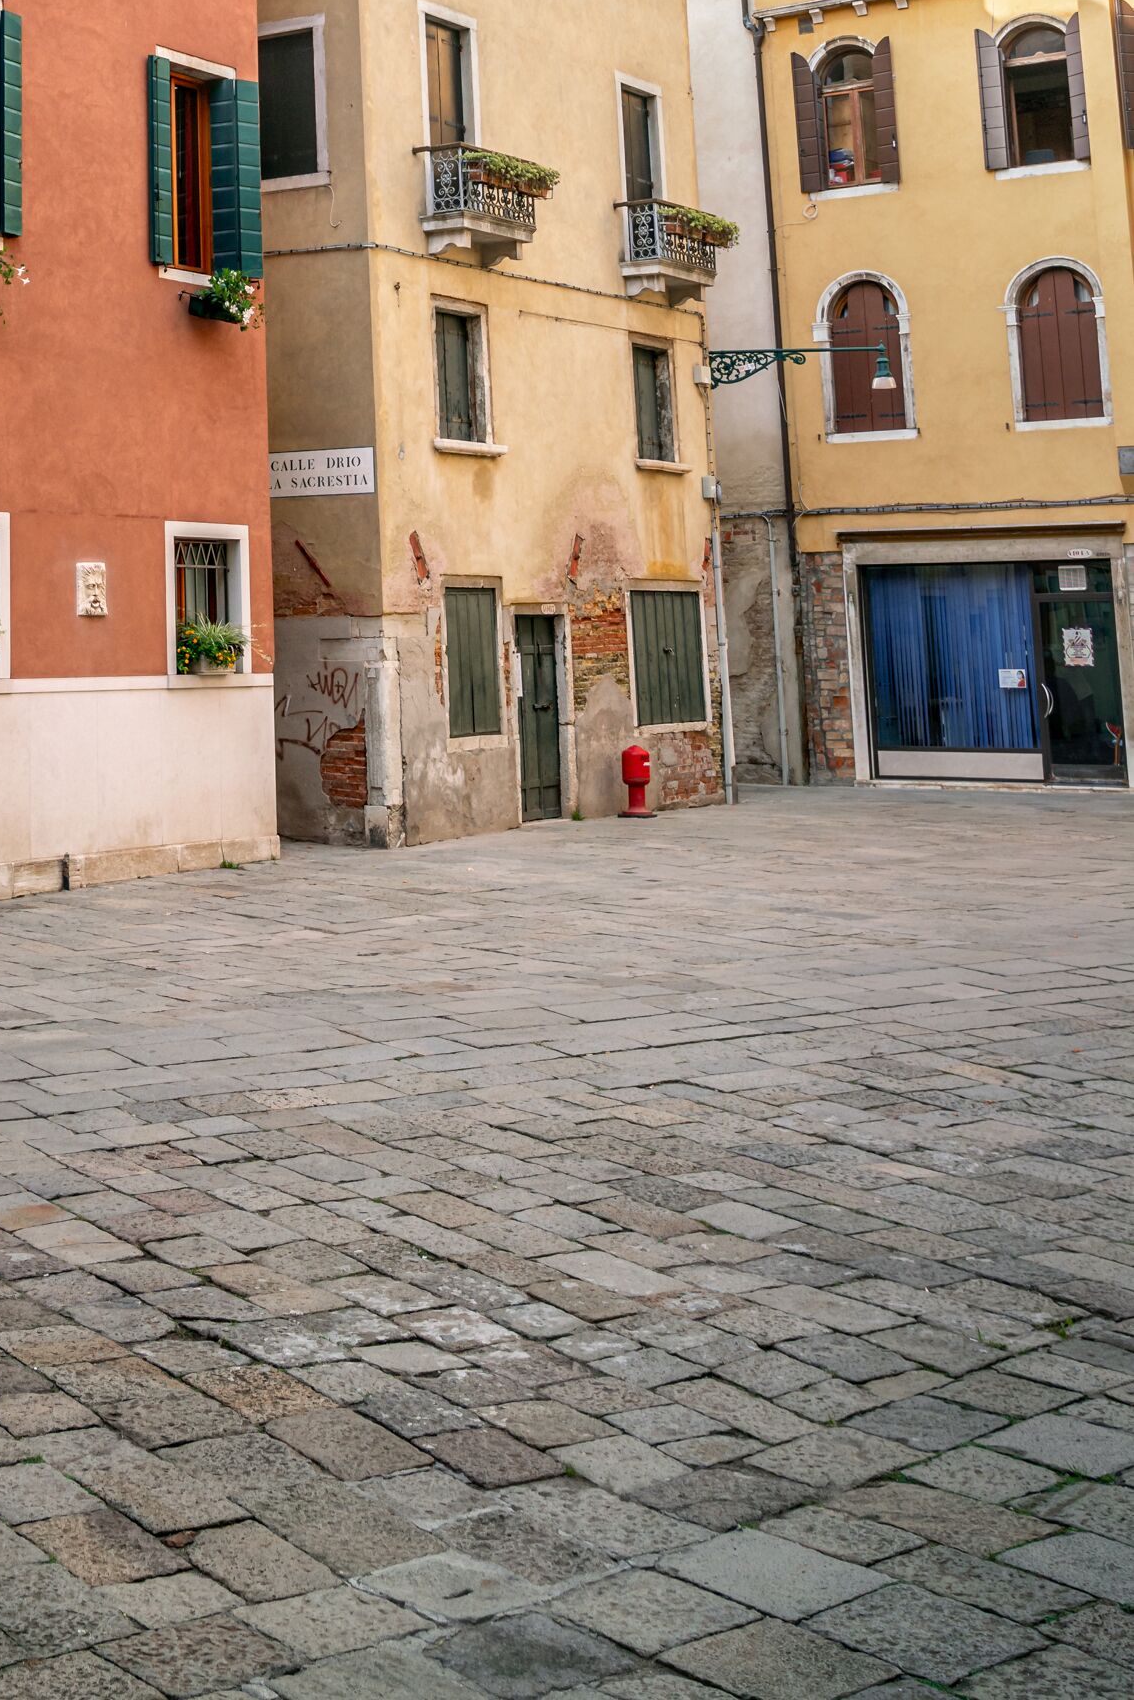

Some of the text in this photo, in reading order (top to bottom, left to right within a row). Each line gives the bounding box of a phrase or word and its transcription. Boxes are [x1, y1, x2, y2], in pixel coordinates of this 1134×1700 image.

[270, 456, 361, 472] CALLE DRIO
[291, 474, 368, 488] SACRESTIA
